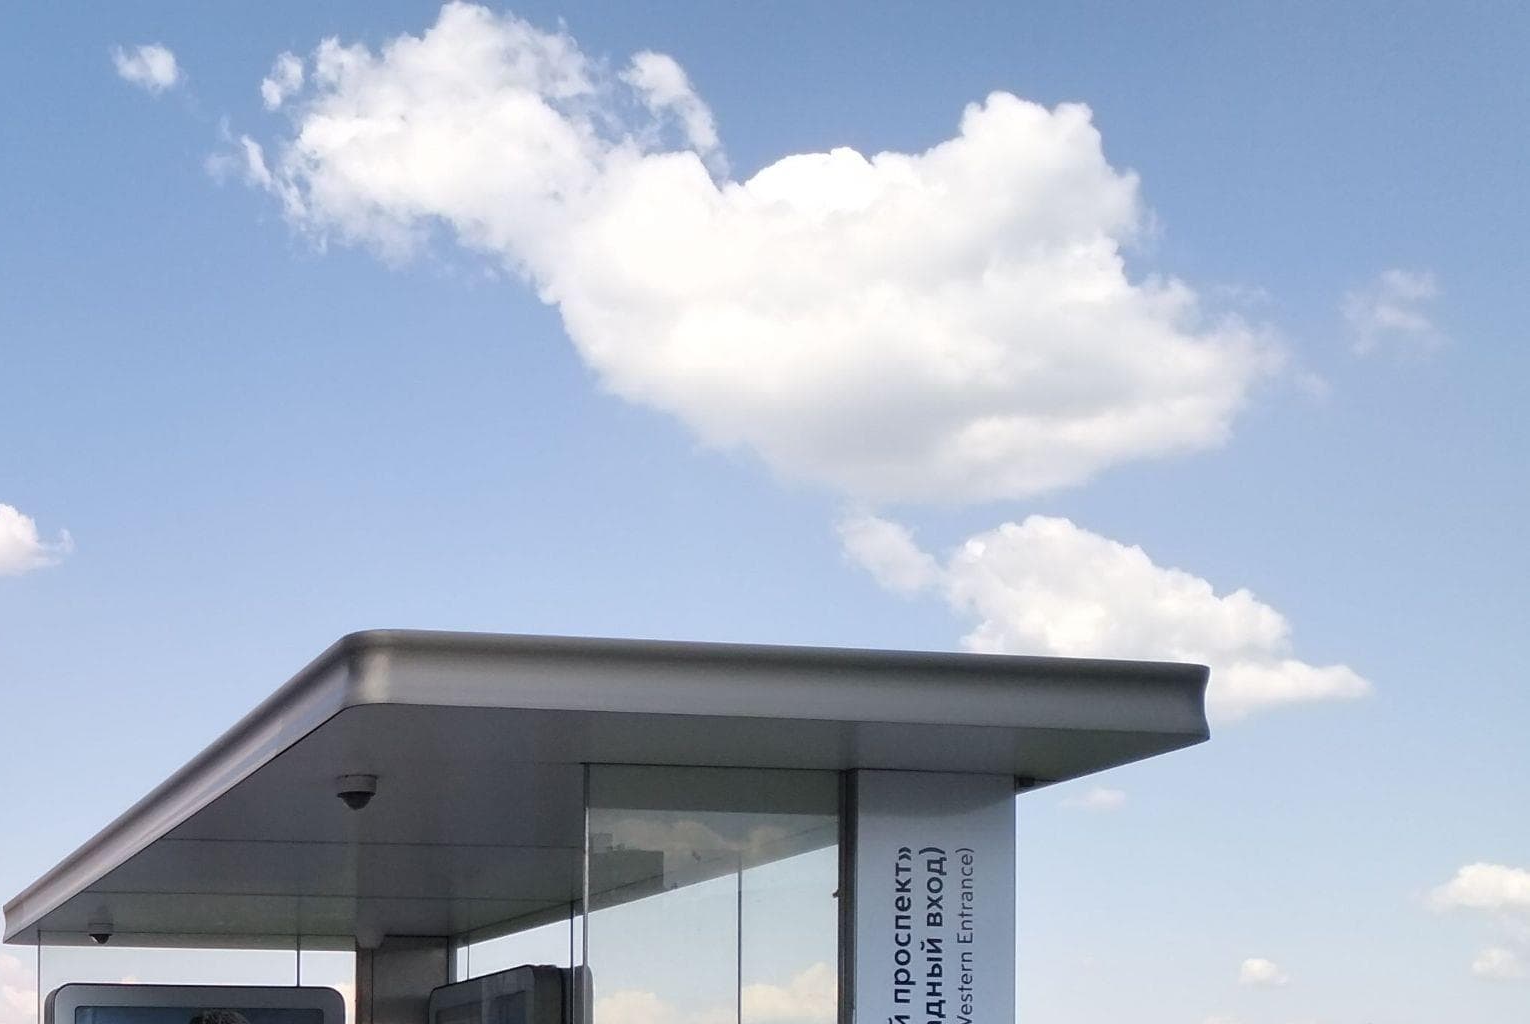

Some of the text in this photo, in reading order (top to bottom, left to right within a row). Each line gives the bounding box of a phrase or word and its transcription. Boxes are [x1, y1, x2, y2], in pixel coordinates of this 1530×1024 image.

[893, 846, 916, 1004] проспект»
[919, 846, 948, 928] вход)
[955, 847, 975, 944] Entrance)
